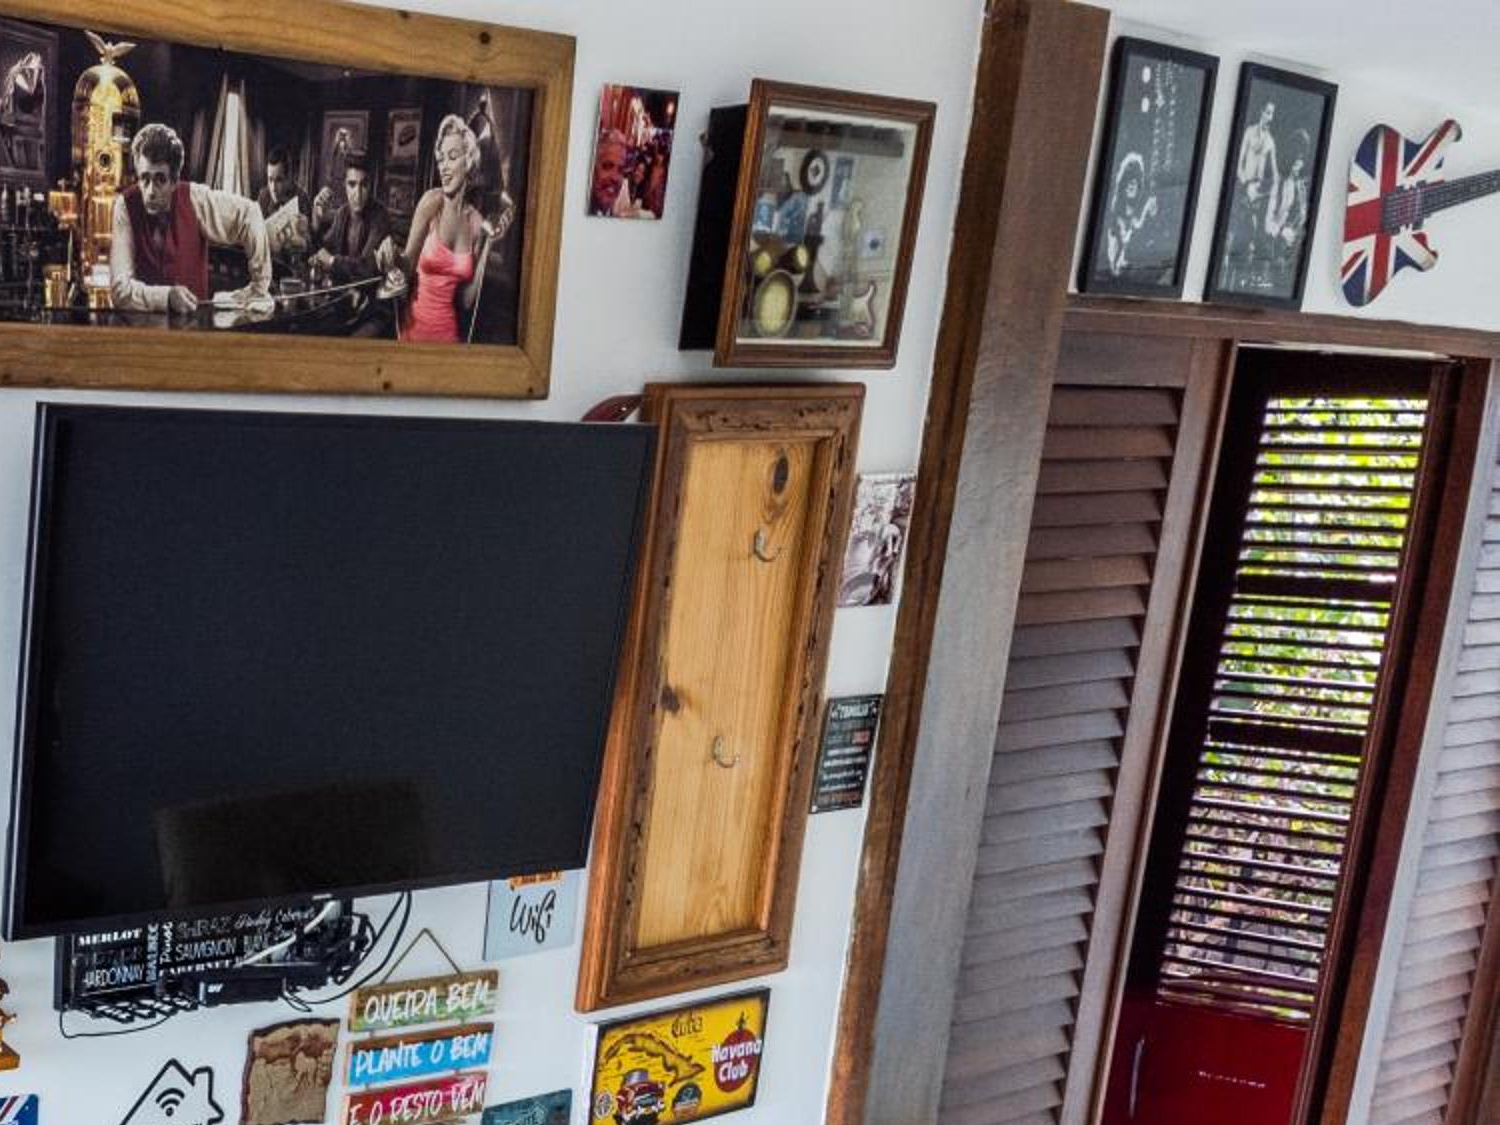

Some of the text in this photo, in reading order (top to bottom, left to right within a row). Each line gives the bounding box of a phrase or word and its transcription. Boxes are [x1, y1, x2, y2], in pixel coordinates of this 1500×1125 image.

[79, 927, 143, 946] MERLOT
[175, 937, 238, 963] SAUVIGNON
[364, 978, 489, 1023] QUEIRA BEM
[355, 1032, 488, 1078] PLANTE O BEM
[711, 1039, 763, 1063] Havana
[717, 1060, 750, 1083] Club
[389, 1089, 443, 1125] RESTO
[451, 1081, 486, 1112] VEM
